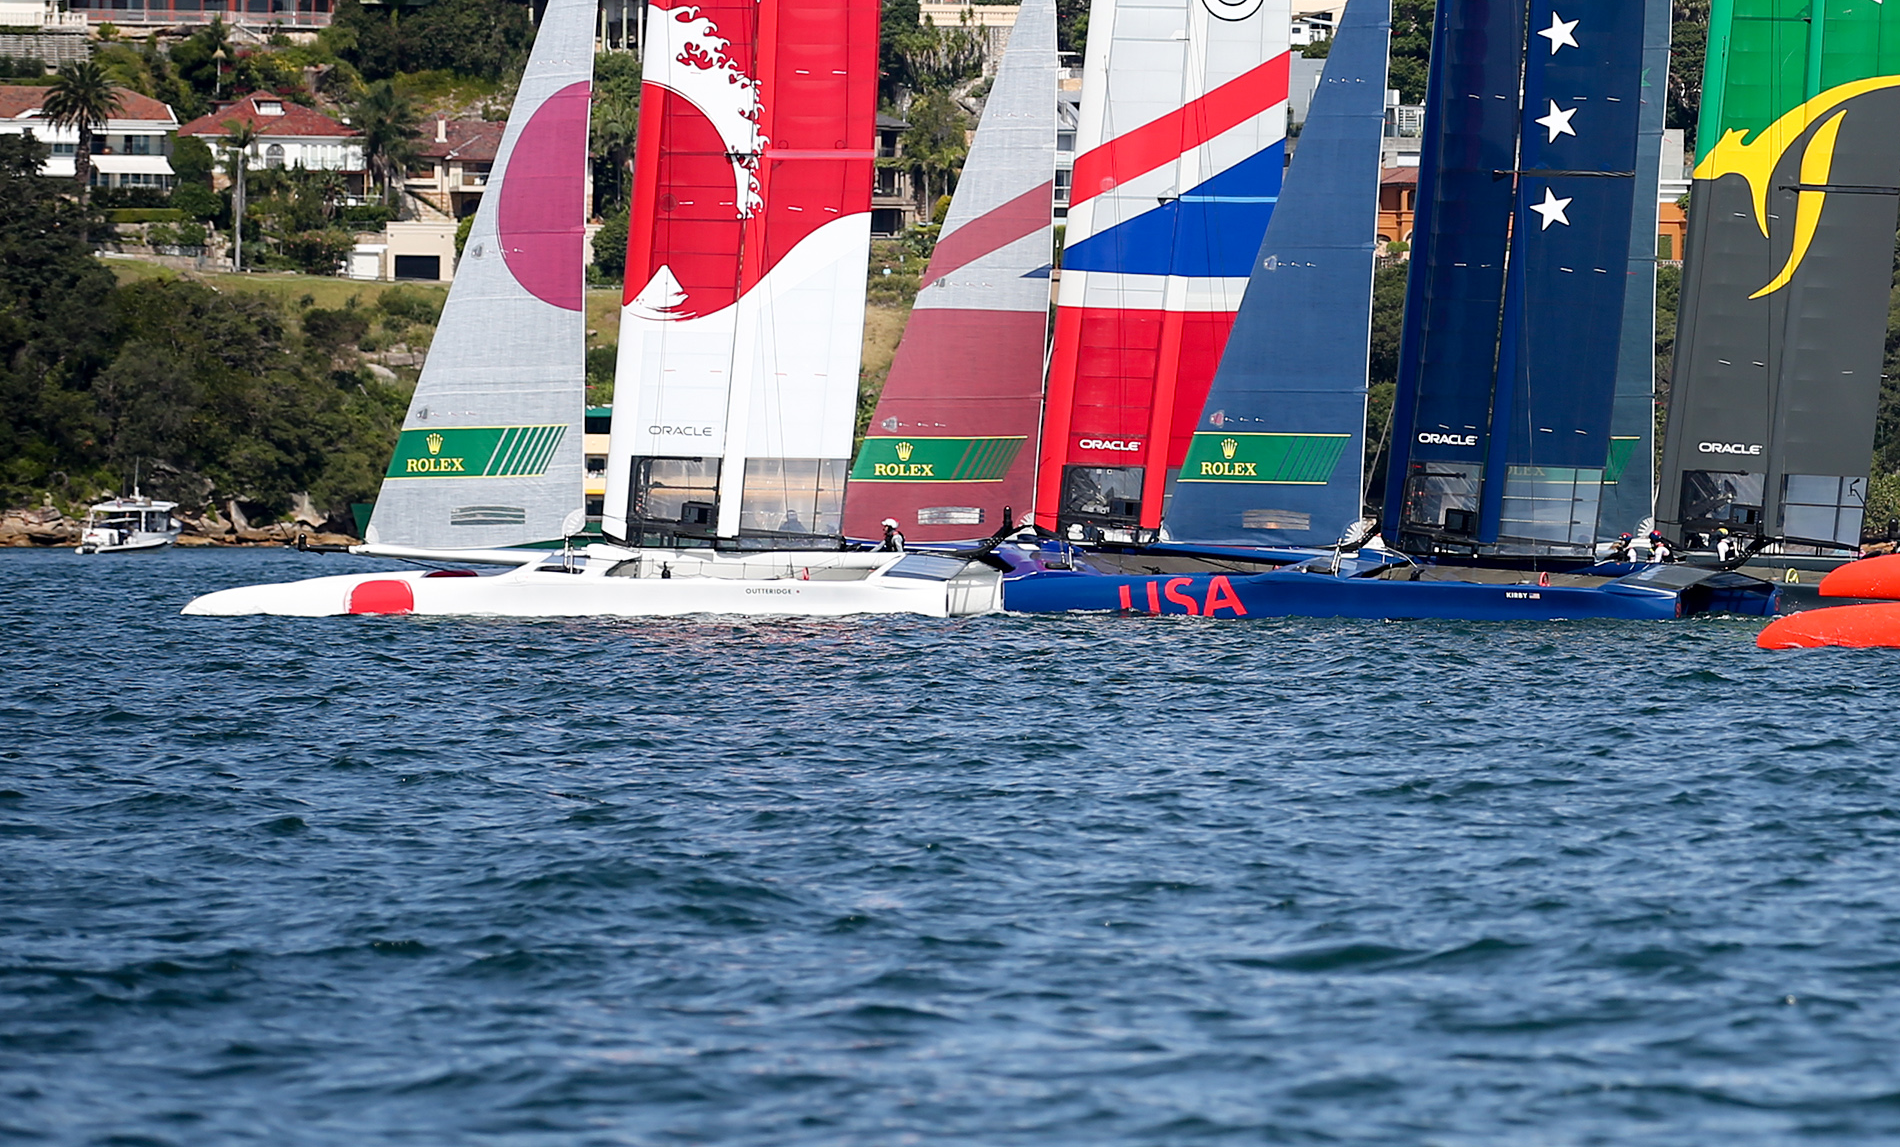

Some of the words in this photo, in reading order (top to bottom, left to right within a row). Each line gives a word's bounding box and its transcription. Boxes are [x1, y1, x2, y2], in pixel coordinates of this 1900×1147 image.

[648, 425, 712, 437] ORACLE
[1079, 439, 1142, 451] ORACLE
[1418, 432, 1478, 446] ORACLE
[1698, 442, 1763, 455] ORACLE
[406, 457, 465, 472] ROLEX
[874, 463, 934, 477] ROLEX
[1200, 461, 1257, 476] ROLEX
[1120, 576, 1248, 617] USA
